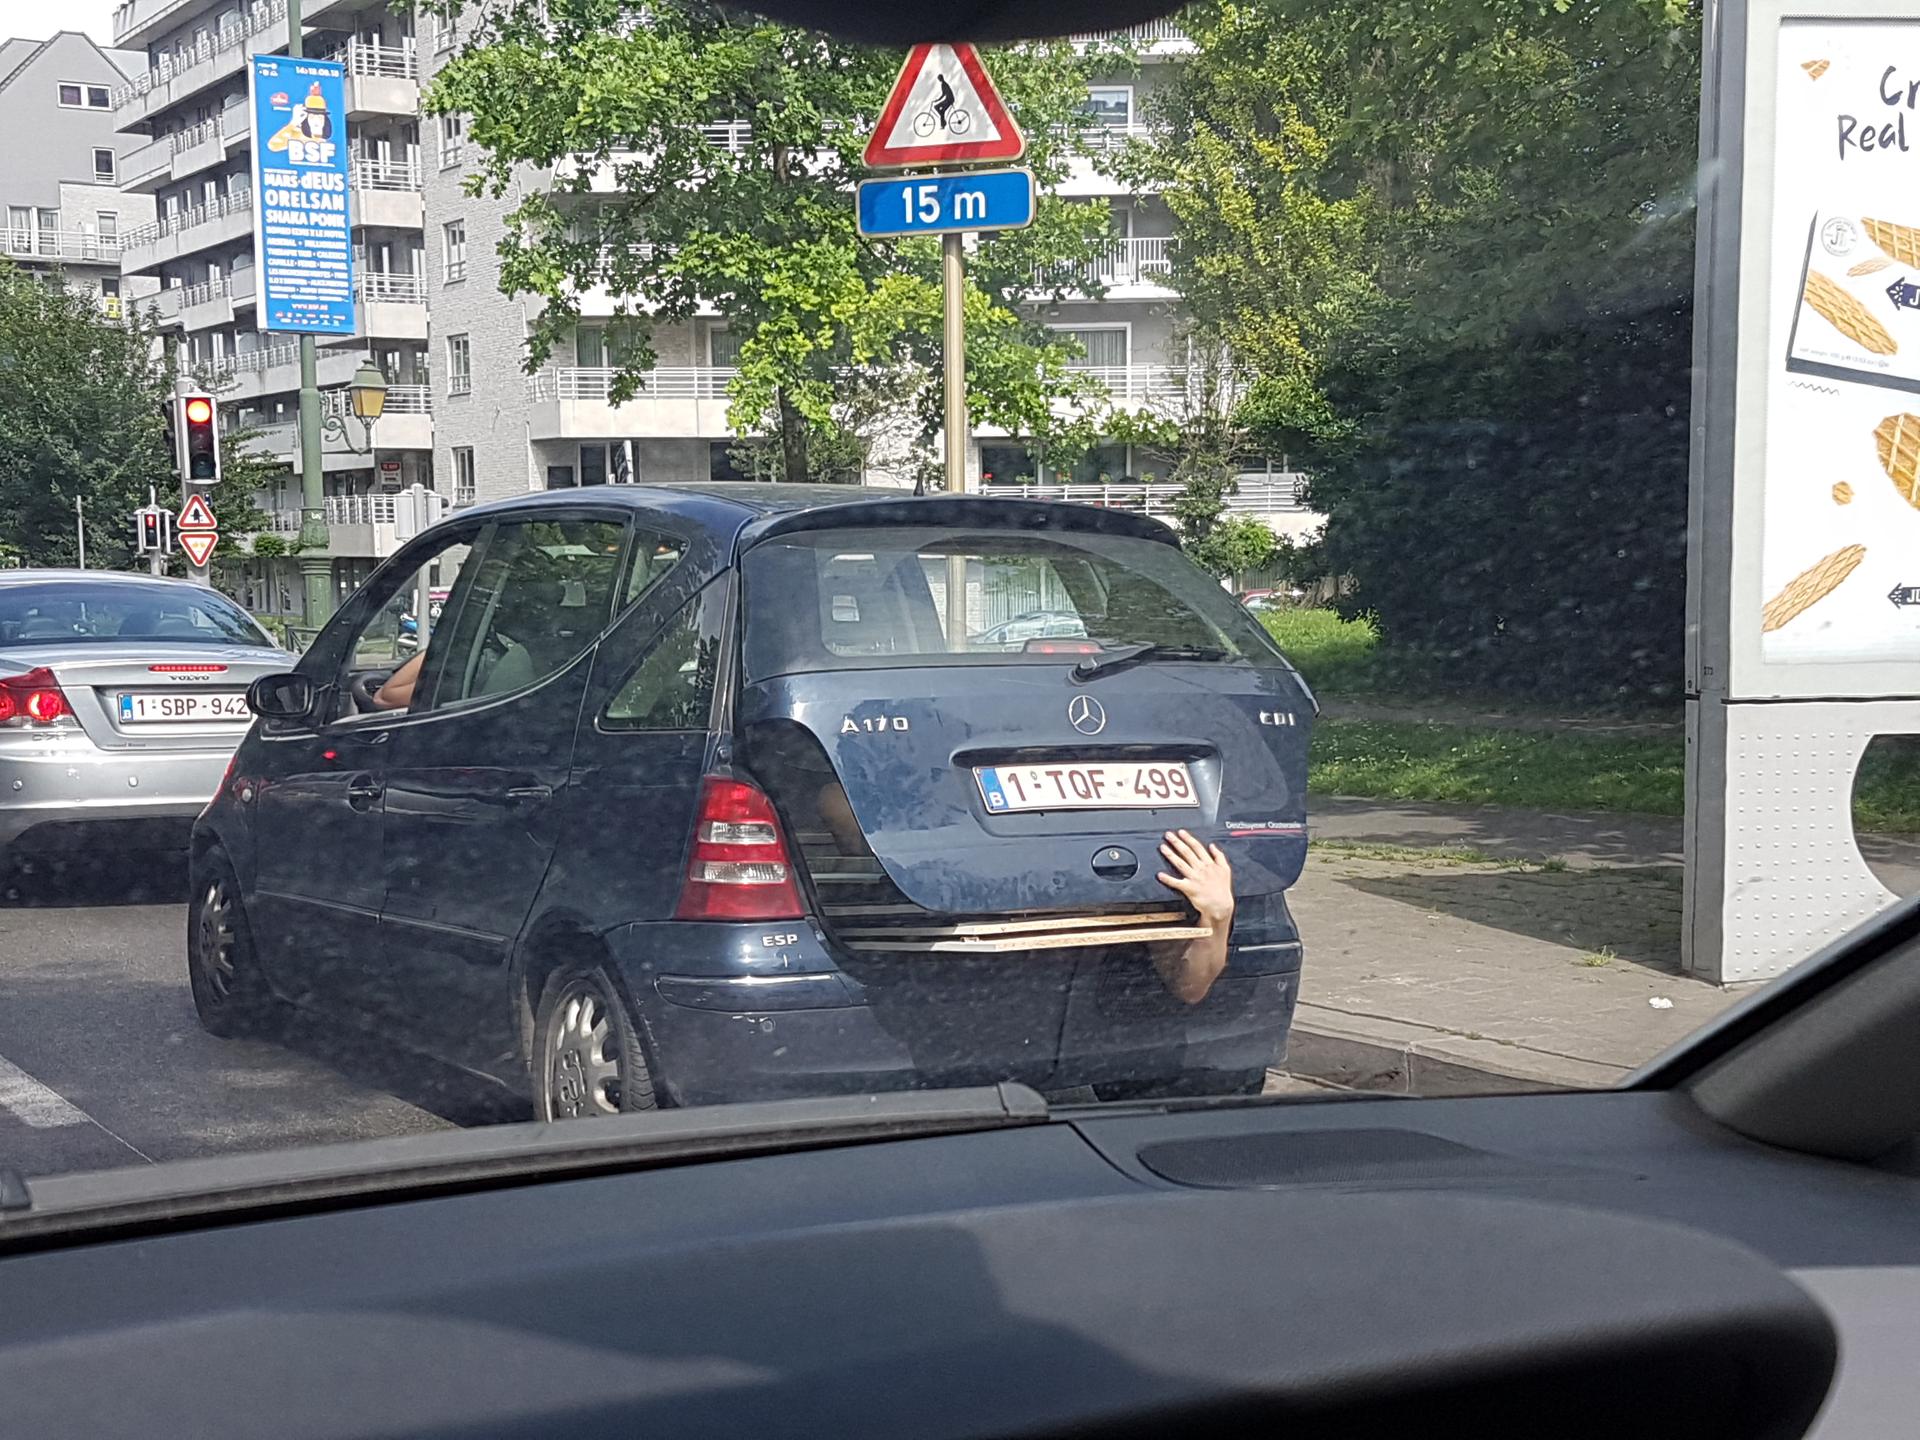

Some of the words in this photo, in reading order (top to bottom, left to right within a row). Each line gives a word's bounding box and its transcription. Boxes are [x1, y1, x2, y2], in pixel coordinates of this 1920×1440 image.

[1838, 112, 1909, 160] Real
[288, 140, 336, 163] BSF
[301, 171, 345, 191] dEUS
[265, 189, 345, 211] ORELSAN
[902, 185, 941, 223] 15
[954, 191, 986, 220] m
[265, 209, 309, 225] SHAKA
[1260, 710, 1296, 726] CDI
[989, 791, 1005, 808] B
[762, 934, 799, 947] ESP
